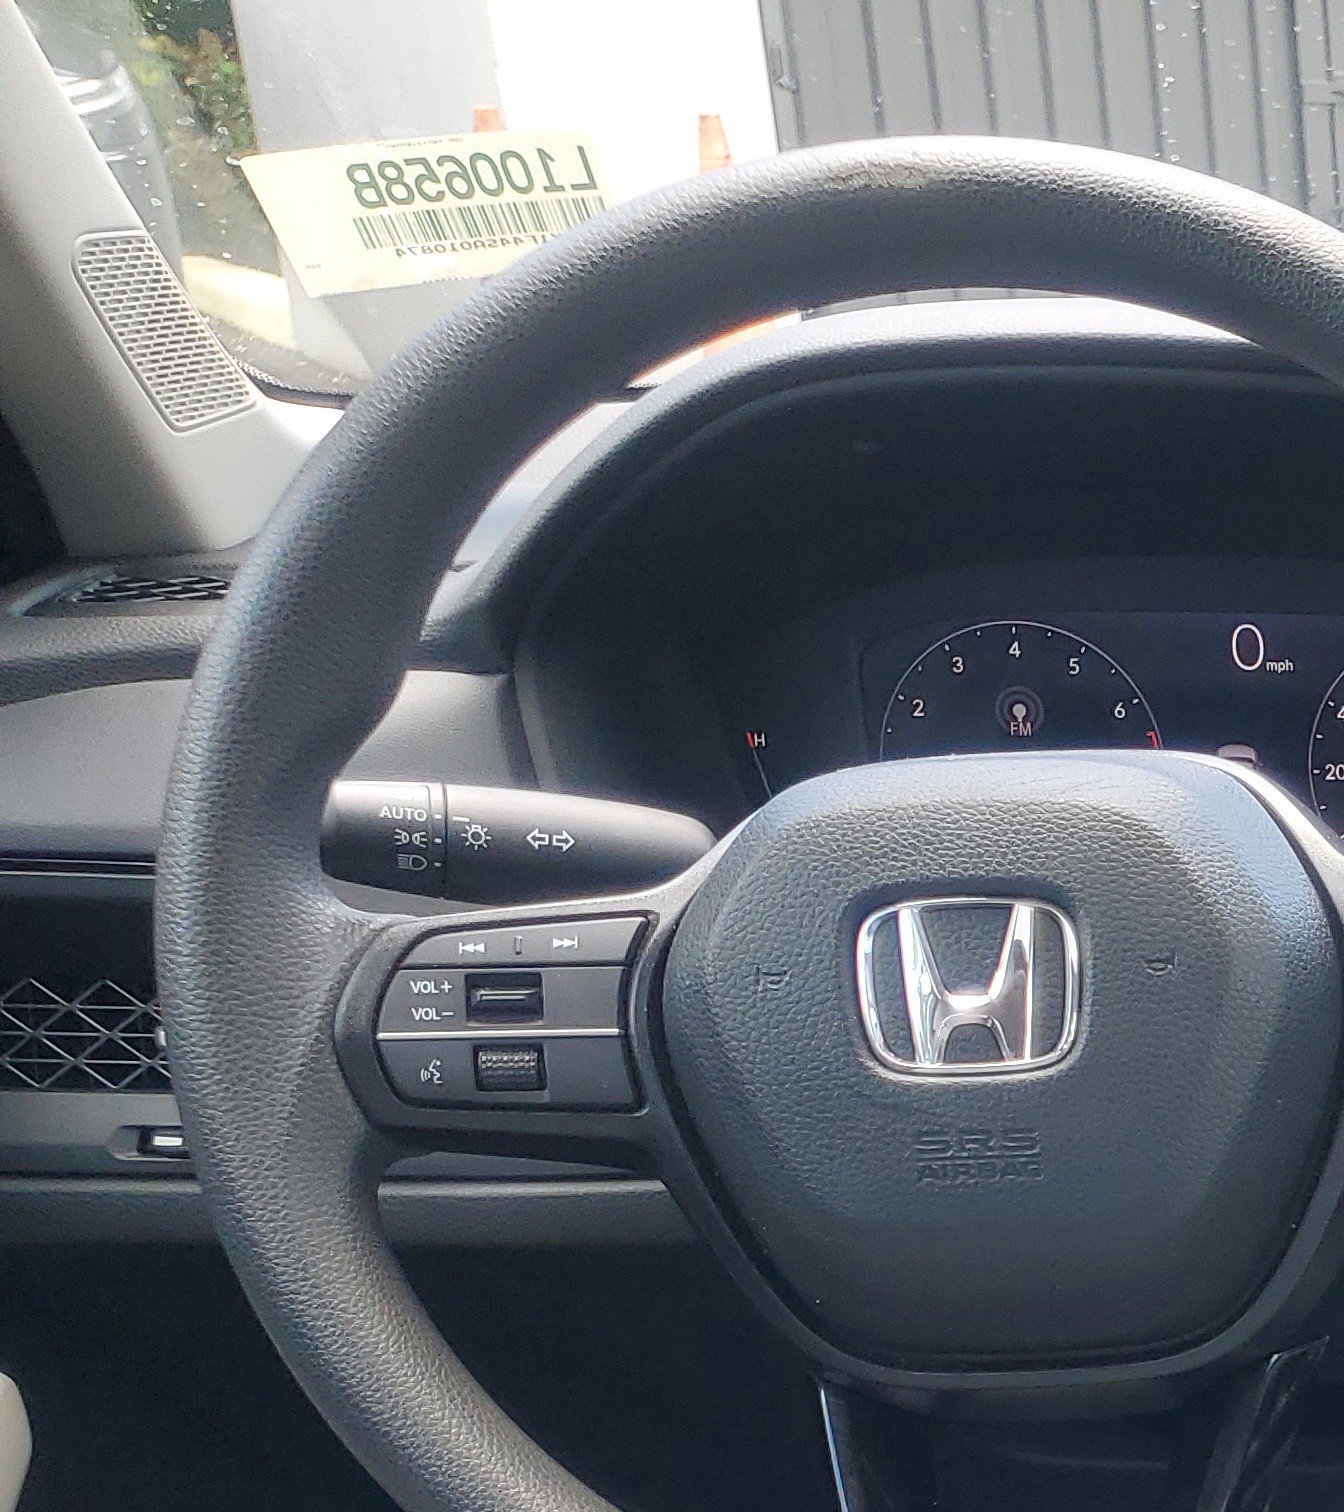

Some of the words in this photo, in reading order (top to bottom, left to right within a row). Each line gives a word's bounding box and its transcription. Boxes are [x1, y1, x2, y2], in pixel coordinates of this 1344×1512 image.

[1008, 641, 1022, 658] 4
[1231, 623, 1265, 671] 0
[1266, 659, 1294, 674] mph
[952, 656, 964, 673] 3
[1069, 657, 1080, 675] 5
[912, 698, 925, 717] 2
[1114, 701, 1126, 719] 6
[1009, 721, 1033, 737] FM
[379, 804, 428, 822] AUTO
